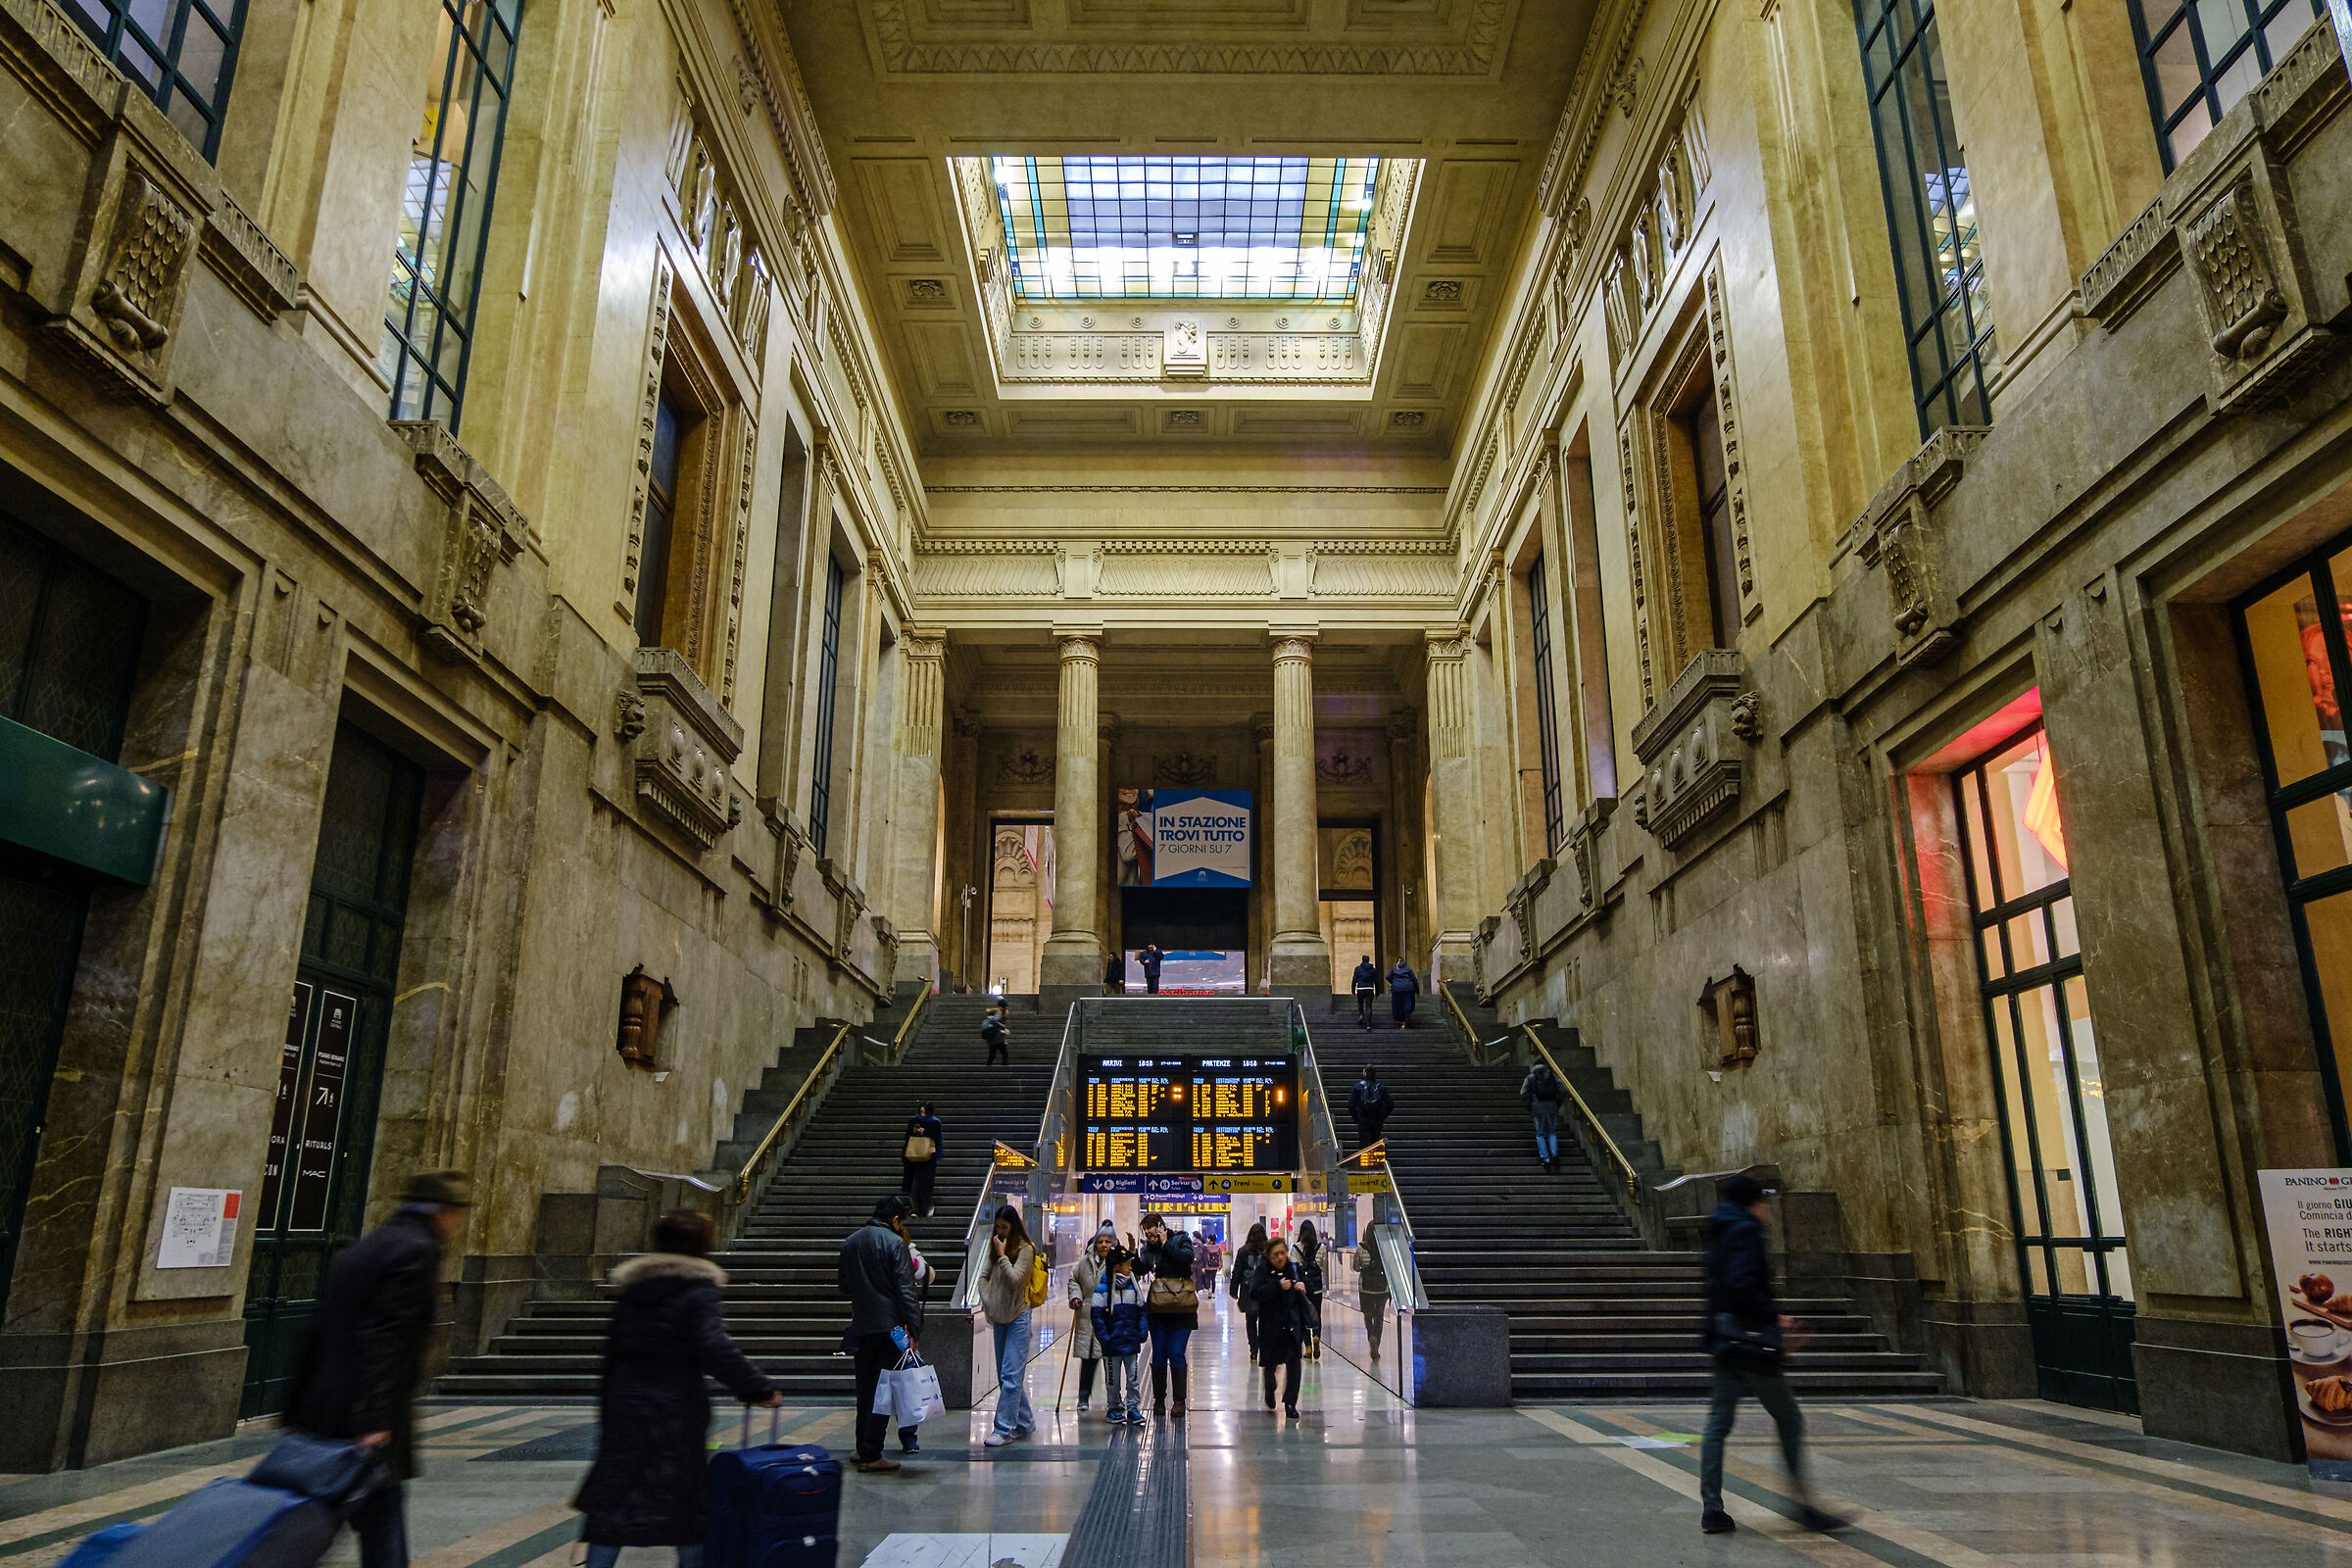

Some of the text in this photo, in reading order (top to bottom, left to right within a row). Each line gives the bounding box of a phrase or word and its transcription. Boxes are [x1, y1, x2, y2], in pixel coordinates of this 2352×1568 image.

[1159, 816, 1246, 828] IN STAZIONE
[1159, 830, 1245, 842] TROVI TUTTO
[1159, 844, 1232, 854] 7 GIORNI SU 7
[306, 1140, 332, 1151] RITUALS
[2306, 1201, 2331, 1210] giorno
[2300, 1211, 2343, 1220] Comincia
[2302, 1228, 2320, 1238] The
[2306, 1241, 2352, 1252] It starts
